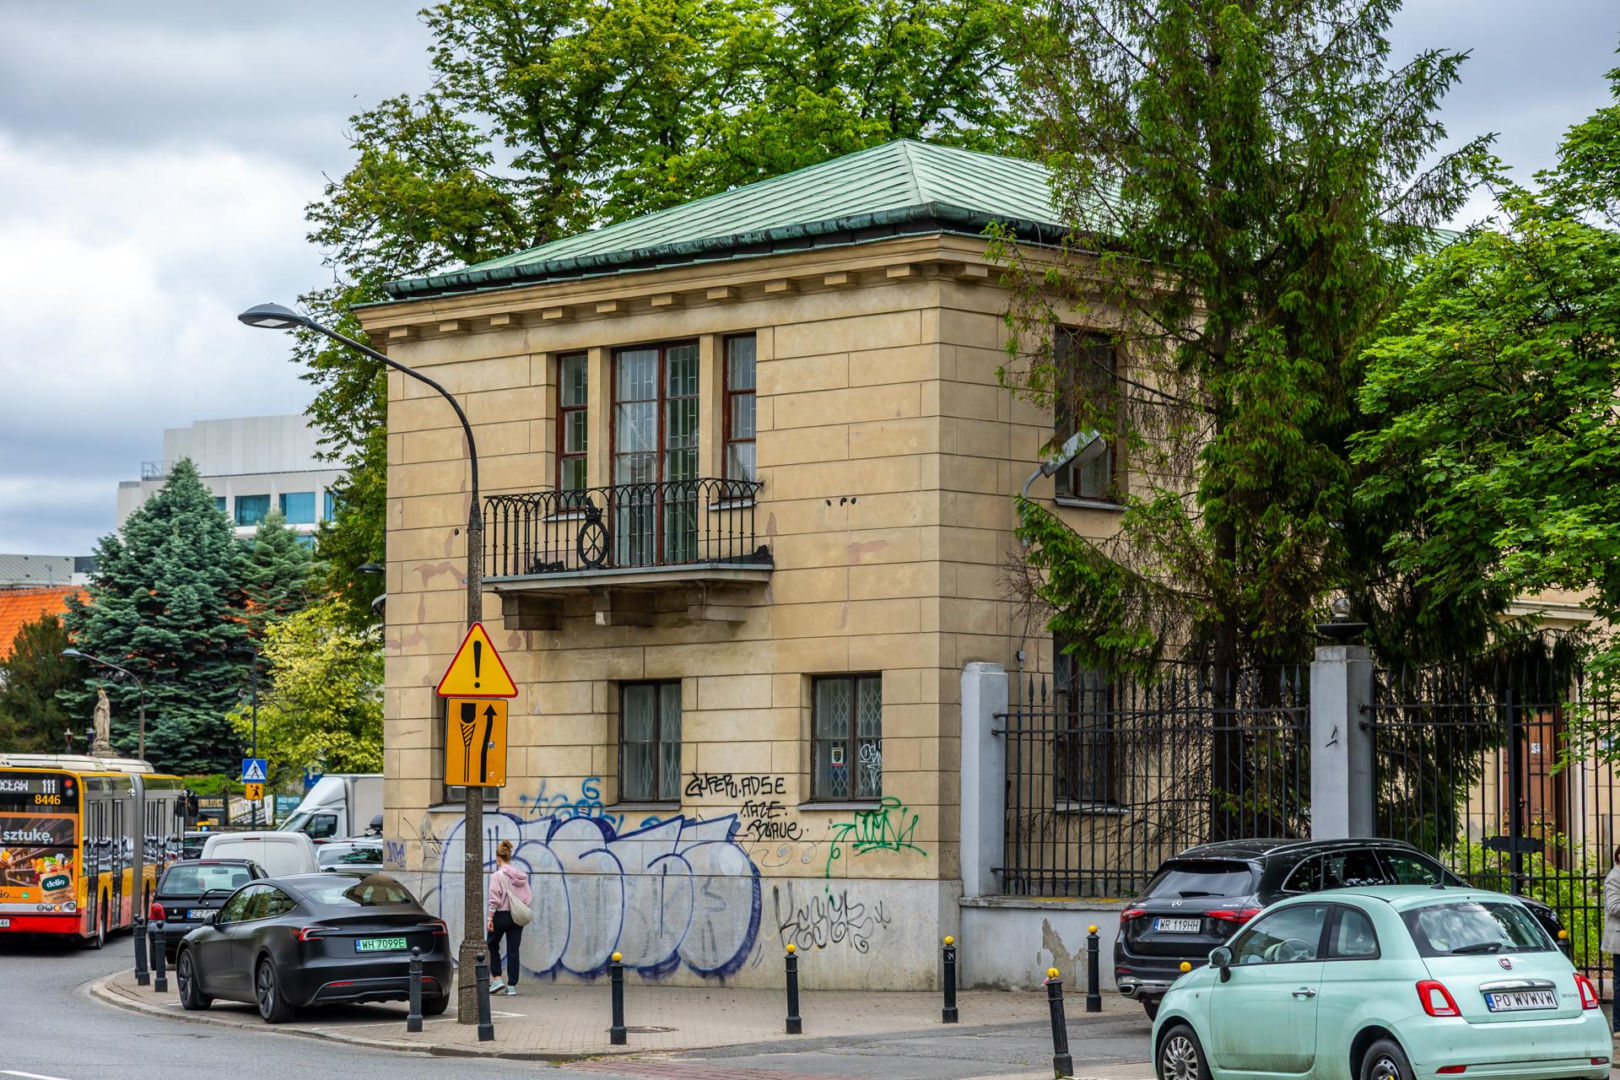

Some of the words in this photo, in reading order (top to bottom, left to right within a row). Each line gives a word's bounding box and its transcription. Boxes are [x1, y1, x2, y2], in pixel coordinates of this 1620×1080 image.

[42, 779, 55, 793] 111
[34, 794, 61, 805] 8446
[3, 828, 54, 844] sztukę,
[1160, 919, 1170, 930] WR
[1173, 919, 1198, 931] 119HH
[361, 940, 375, 950] WH
[377, 938, 405, 949] 7099E
[1513, 991, 1554, 1006] WVWVW
